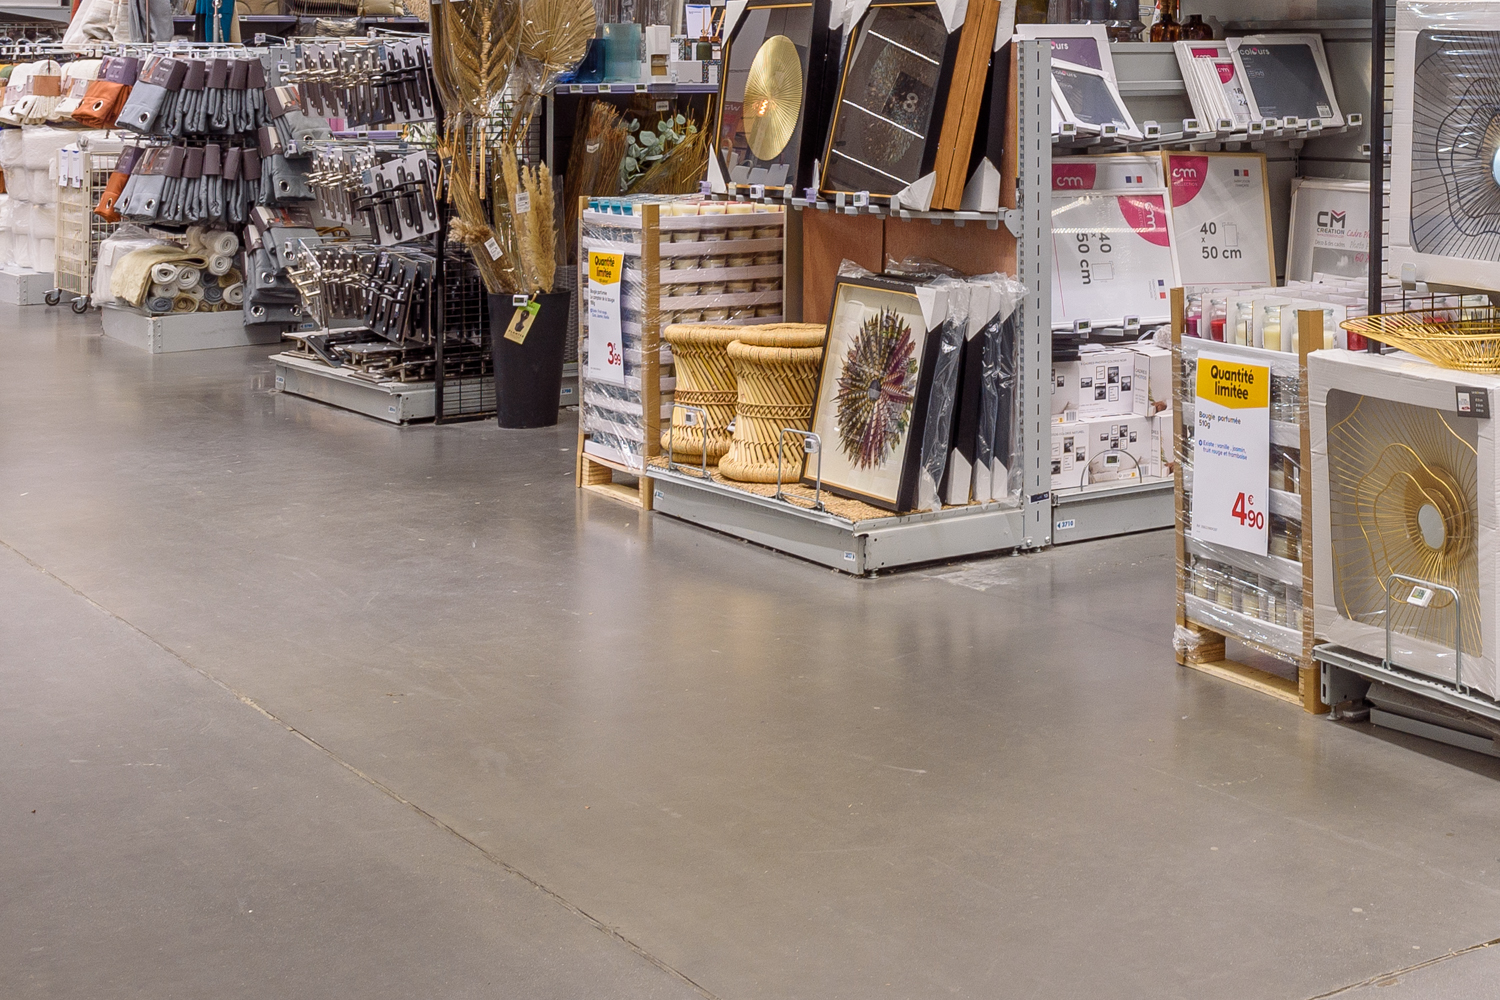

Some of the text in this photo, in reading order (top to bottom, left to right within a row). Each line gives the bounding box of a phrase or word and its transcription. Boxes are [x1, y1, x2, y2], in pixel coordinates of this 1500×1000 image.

[1050, 41, 1069, 50] ours
[1200, 222, 1217, 235] 40
[1316, 209, 1346, 229] CM
[1098, 232, 1112, 253] 40
[1076, 233, 1092, 285] 50 cm
[1202, 246, 1242, 260] 50 cm
[1210, 364, 1254, 385] Quantité
[1214, 381, 1249, 400] limitée
[1198, 411, 1242, 426] Bougie parfumée
